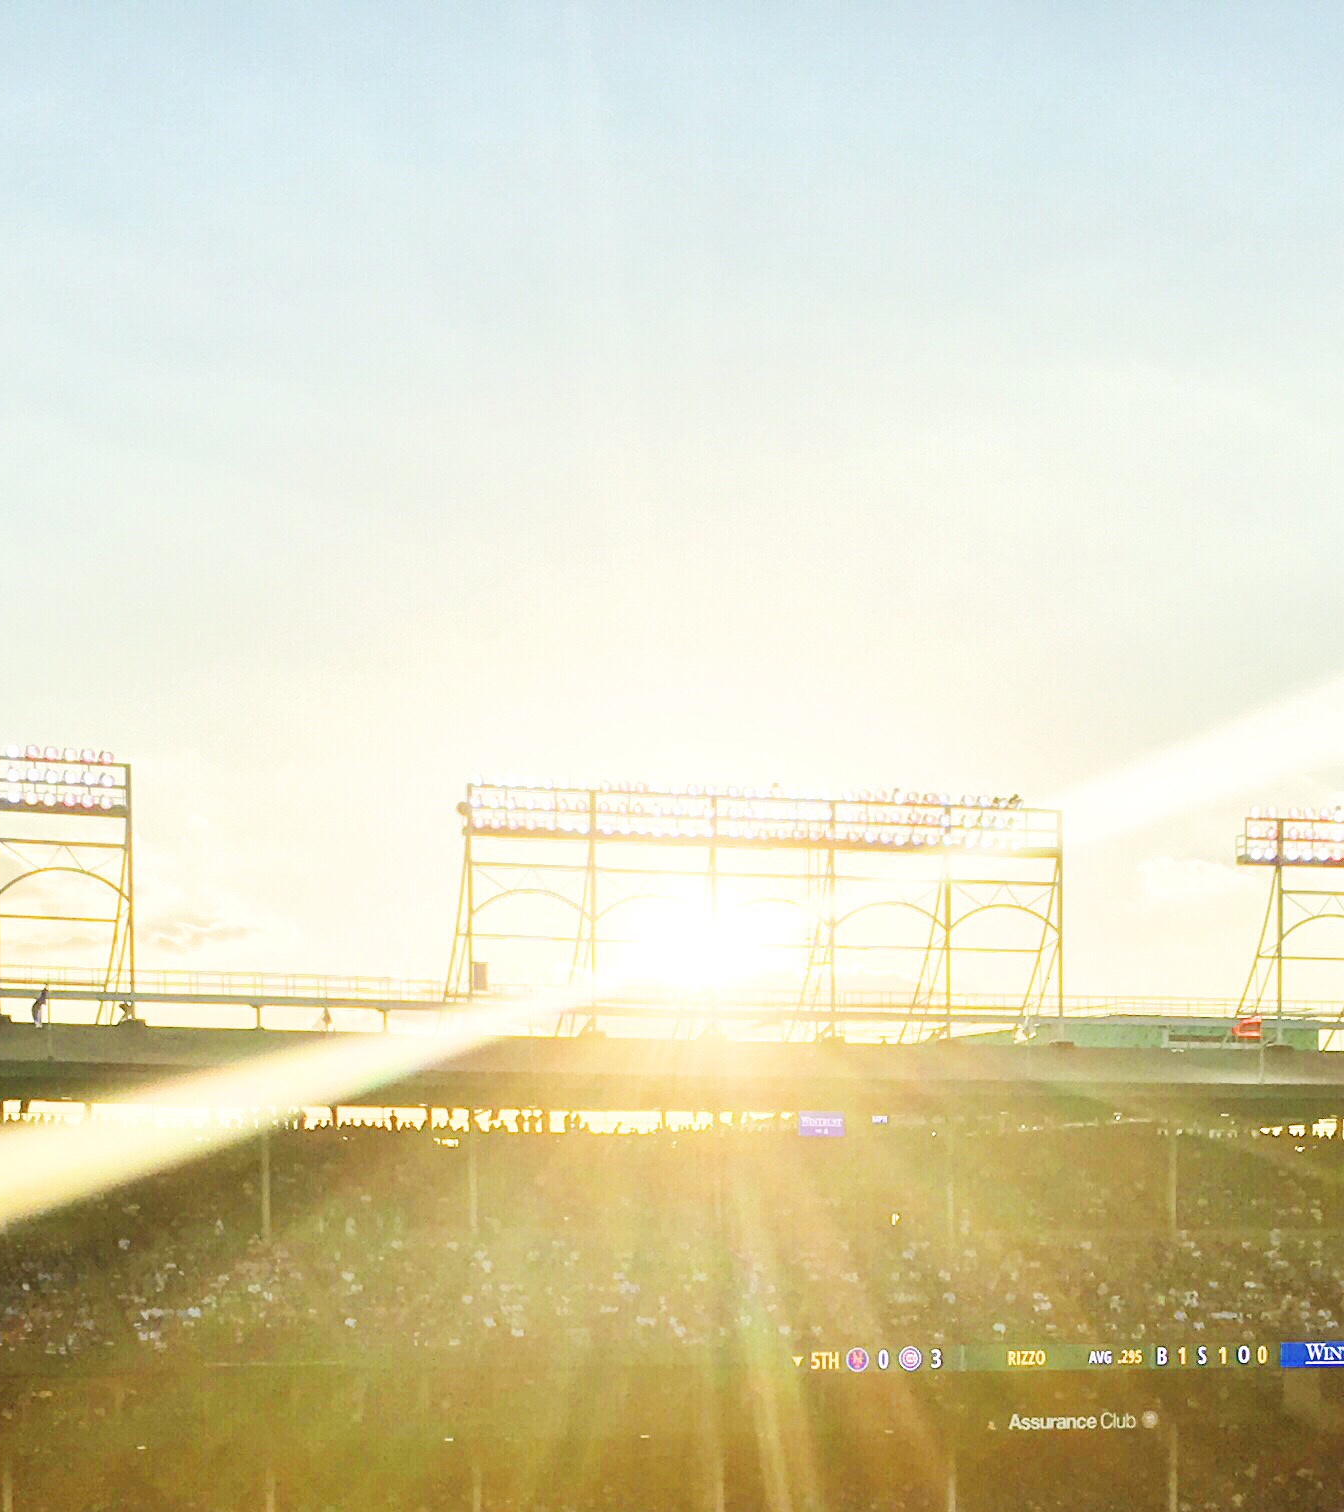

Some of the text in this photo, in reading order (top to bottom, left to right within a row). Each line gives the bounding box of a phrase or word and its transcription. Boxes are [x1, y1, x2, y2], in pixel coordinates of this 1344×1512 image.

[810, 1351, 841, 1370] 5TH
[878, 1349, 889, 1370] 0
[930, 1348, 943, 1370] 3
[1008, 1349, 1144, 1366] RIZZO AVG .295
[1157, 1346, 1169, 1366] B
[1177, 1346, 1187, 1365] 1
[1197, 1346, 1207, 1365] S
[1218, 1346, 1228, 1365] 1
[1008, 1411, 1137, 1431] Assurance Club
